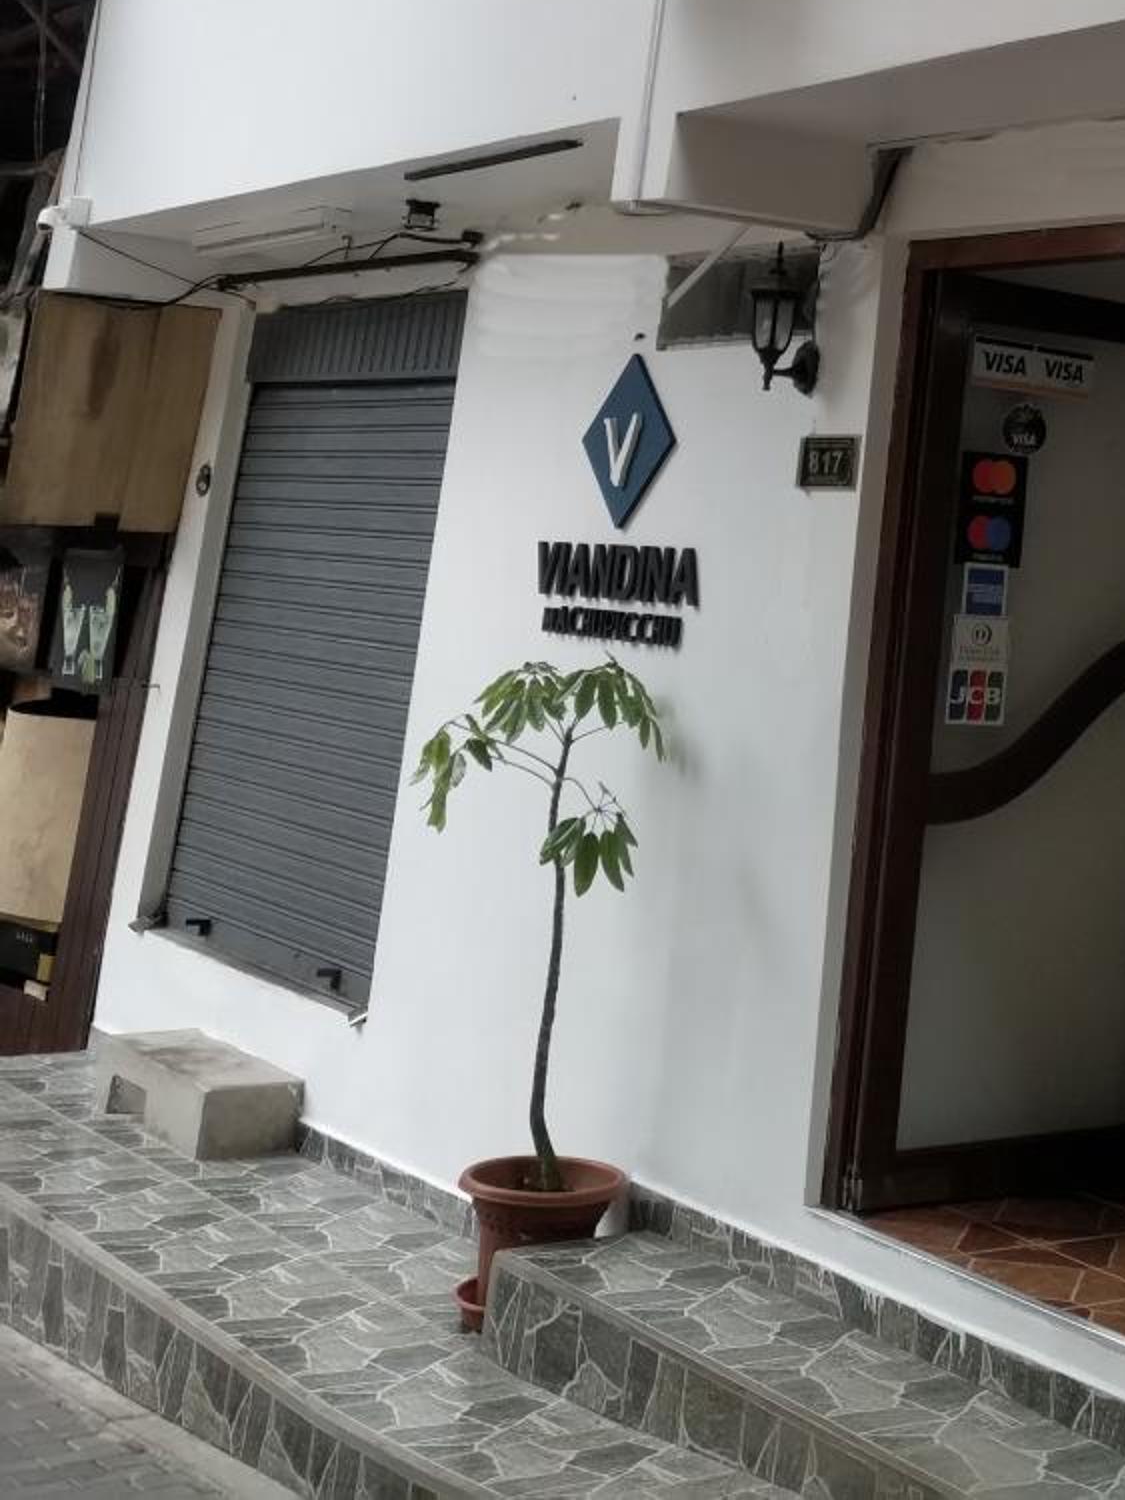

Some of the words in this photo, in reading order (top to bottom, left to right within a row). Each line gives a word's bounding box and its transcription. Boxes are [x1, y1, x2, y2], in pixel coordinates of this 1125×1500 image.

[983, 351, 1027, 376] VISA
[1044, 358, 1085, 383] VISA
[809, 450, 844, 475] 817
[537, 540, 700, 608] VIANDINA
[950, 685, 1002, 705] JCB
